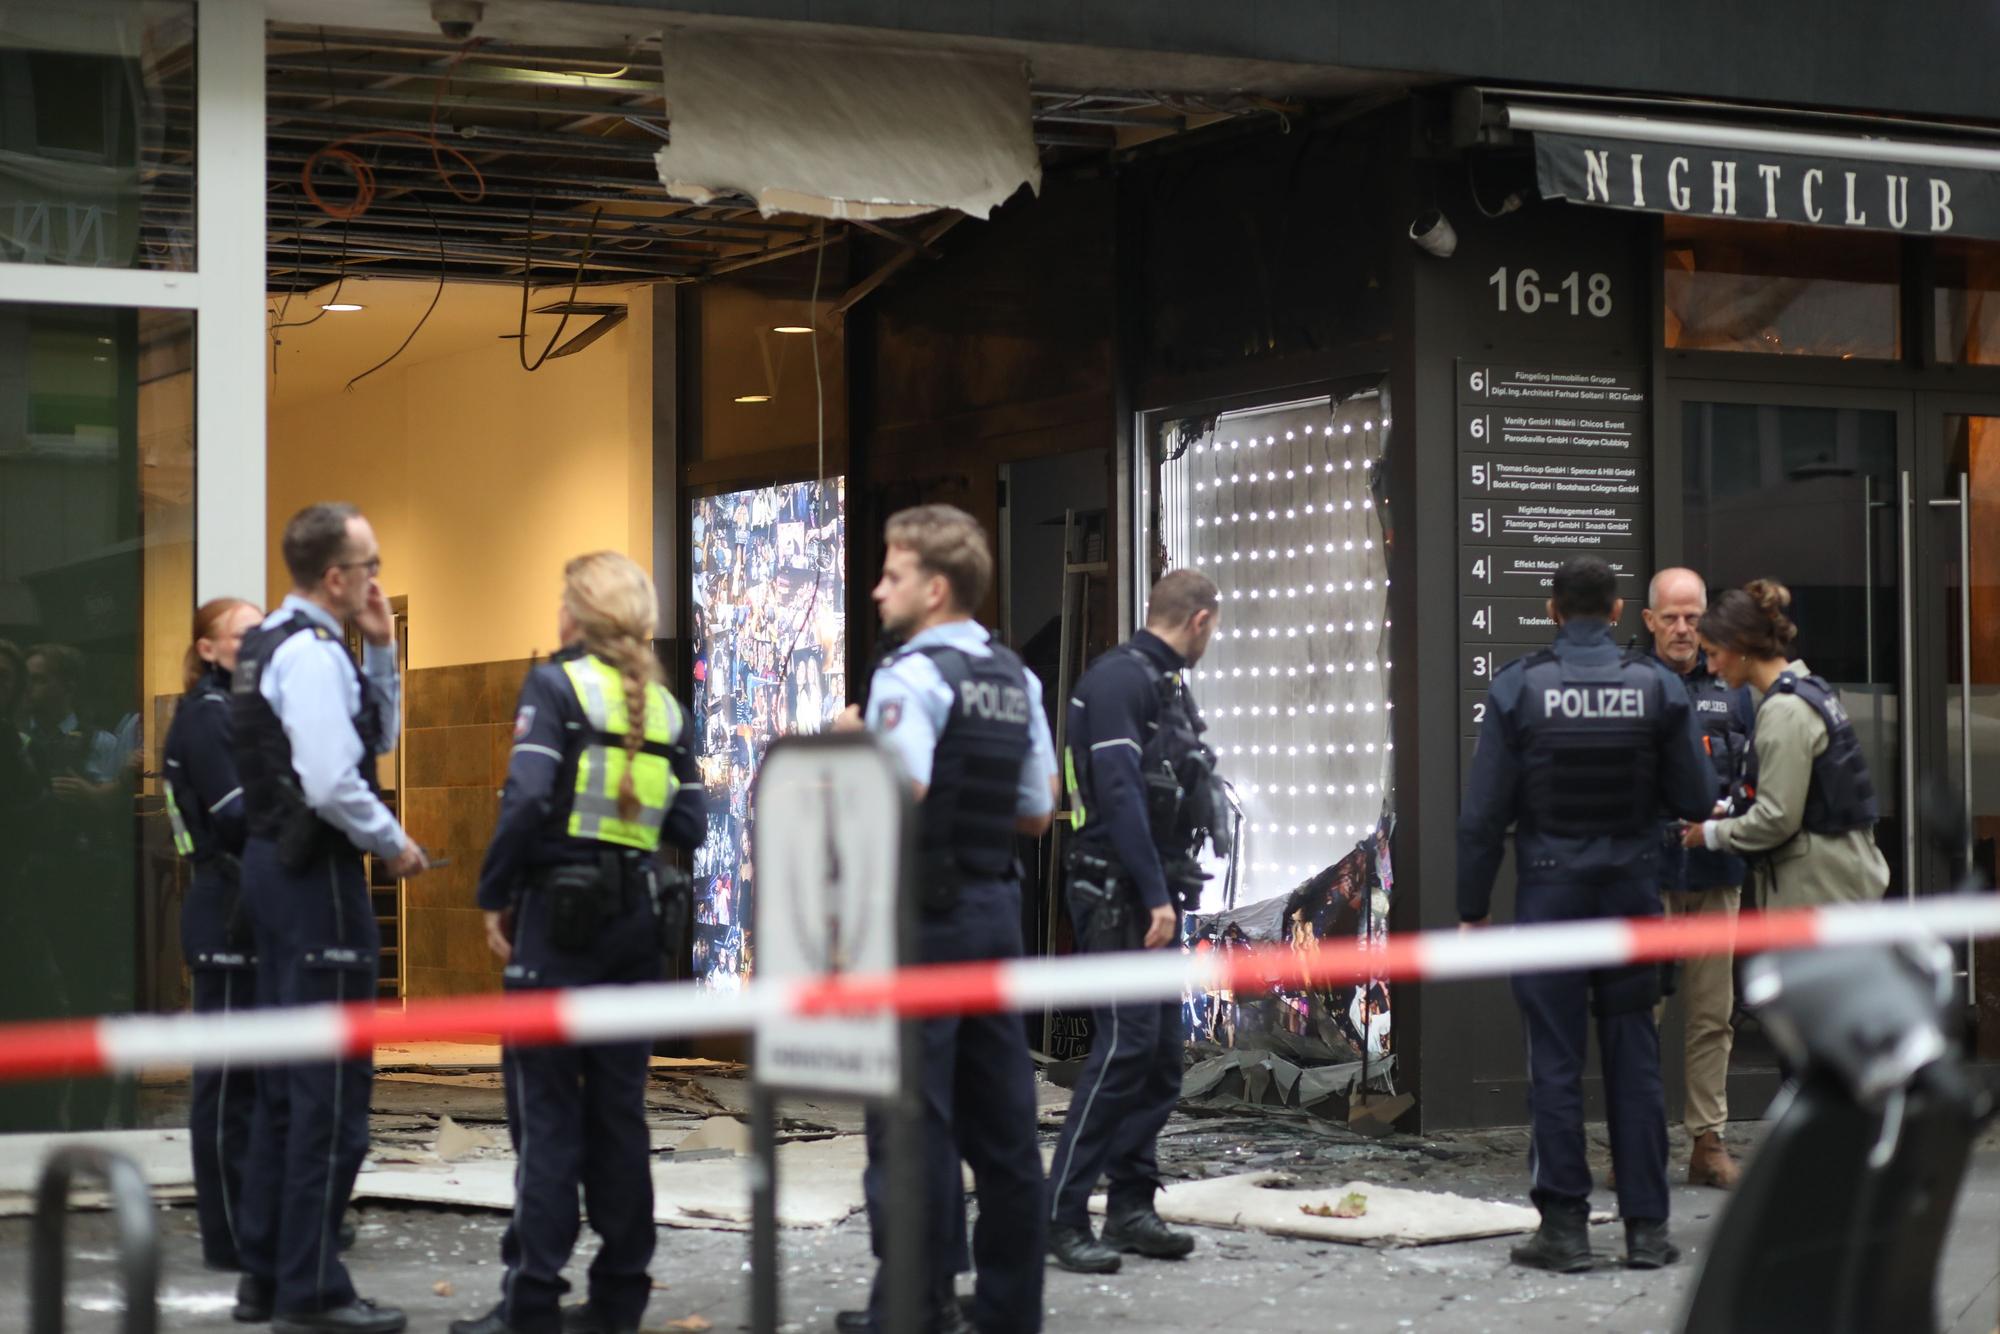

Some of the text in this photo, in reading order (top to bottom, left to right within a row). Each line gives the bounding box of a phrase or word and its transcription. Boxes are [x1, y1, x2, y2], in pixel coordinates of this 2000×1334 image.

[1584, 149, 1955, 233] NIGHTCLUB
[1488, 265, 1613, 319] 16-18
[1470, 371, 1484, 391] 6
[1515, 371, 1616, 385] Füngeling Immobilien Gruppe
[1522, 388, 1554, 397] Architekt
[1555, 389, 1580, 398] Farhad
[1580, 390, 1604, 400] Soltani
[1622, 392, 1644, 401] GmbH
[1470, 418, 1484, 438] 6
[1504, 417, 1528, 426] Vanity
[1528, 418, 1551, 426] GmbH
[1580, 420, 1604, 428] Chicos
[1604, 421, 1625, 429] Event
[1504, 434, 1629, 449] Parookaville GmbH Cologne Clubbing
[1472, 465, 1485, 485] 5
[1496, 464, 1523, 472] Thomas
[1524, 465, 1544, 474] Group
[1544, 466, 1567, 474] GmbH
[1570, 467, 1597, 476] Spencer
[1602, 468, 1614, 476] Hill
[1614, 468, 1636, 476] GmbH
[1493, 480, 1640, 494] Book Kings GmbH Bootshaus Cologne GmbH
[1518, 506, 1616, 517] Nightlife Management GmbH
[1472, 513, 1485, 533] 5
[1505, 520, 1538, 530] Flamingo
[1538, 520, 1558, 530] Royal
[1558, 520, 1580, 529] GmbH
[1607, 522, 1629, 530] GmbH
[1533, 534, 1601, 544] Springinsfeld GmbH
[1472, 560, 1486, 579] 4
[1514, 560, 1536, 568] Effekt
[1536, 560, 1560, 570] Media
[1472, 610, 1486, 629] 4
[1518, 616, 1558, 626] Tradewin
[1473, 656, 1486, 677] 3
[1544, 688, 1644, 718] POLIZEI
[1696, 699, 1728, 713] POLIZEI
[1473, 703, 1486, 723] 2
